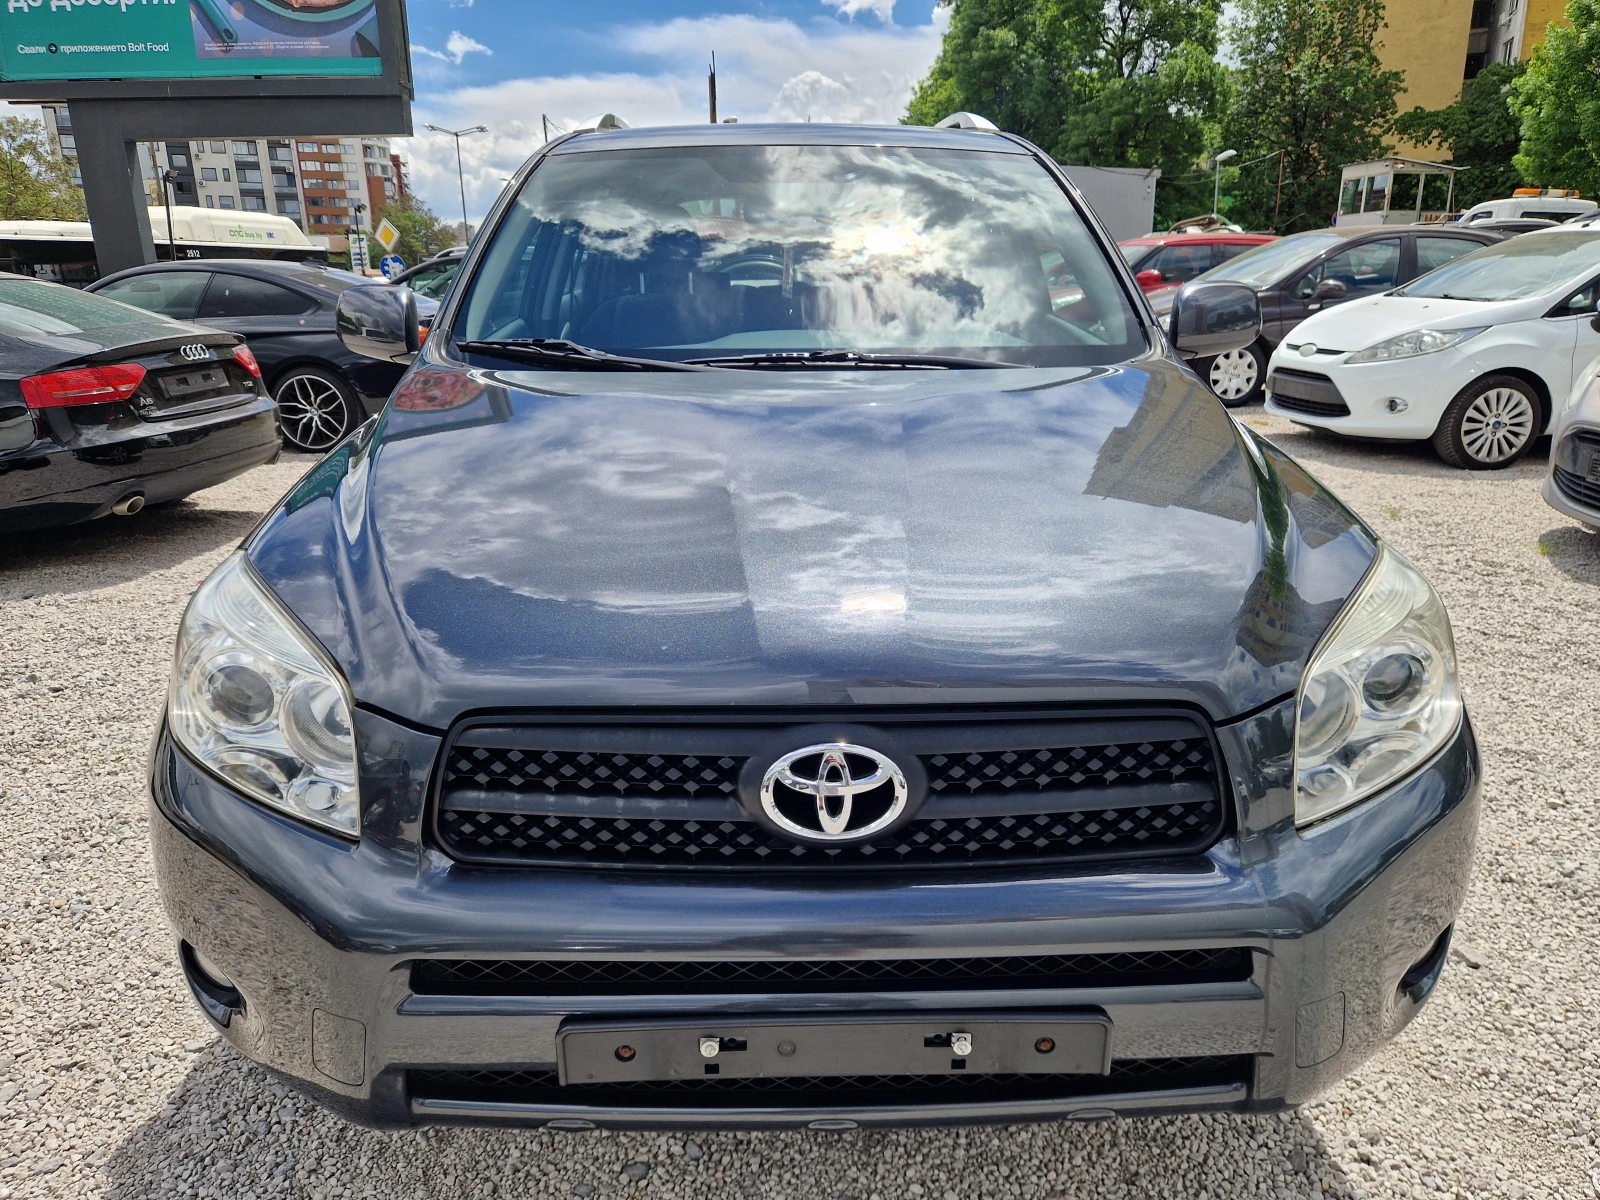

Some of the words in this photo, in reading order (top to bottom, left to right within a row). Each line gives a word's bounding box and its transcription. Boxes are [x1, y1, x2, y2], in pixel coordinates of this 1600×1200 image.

[17, 44, 47, 54] Свали
[60, 44, 127, 55] приложението
[128, 43, 146, 52] Bolt
[147, 42, 170, 52] Food
[255, 231, 262, 240] by
[186, 249, 200, 257] 2512
